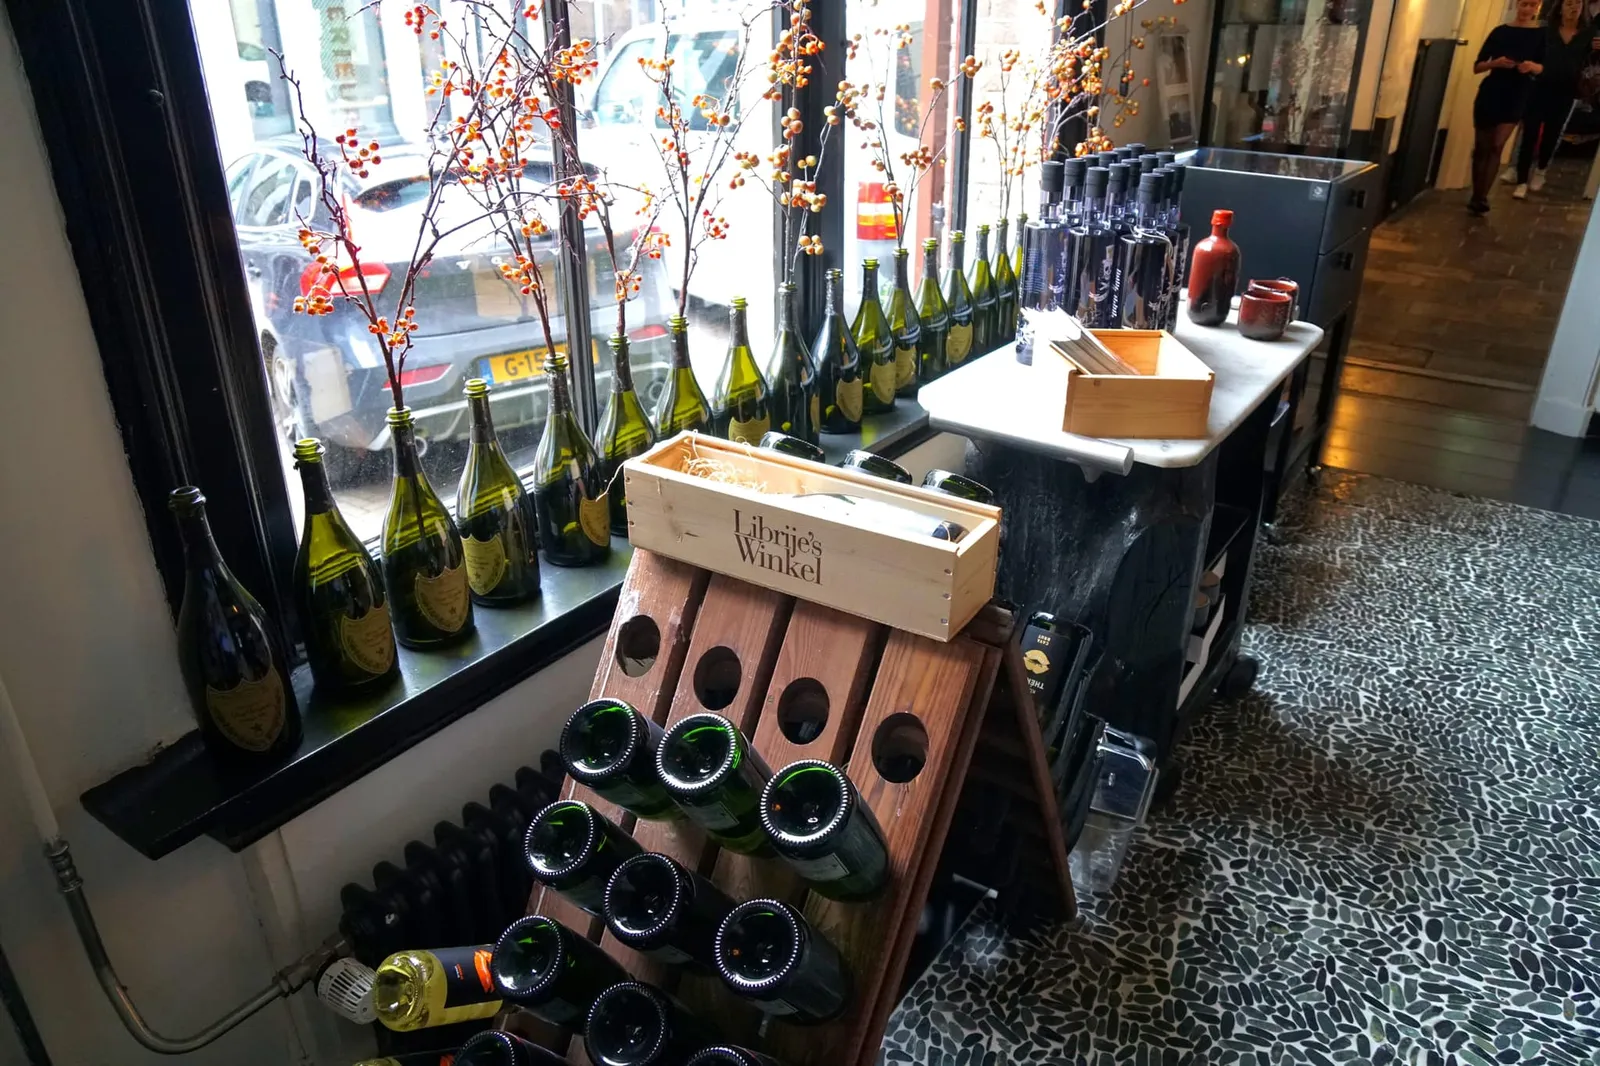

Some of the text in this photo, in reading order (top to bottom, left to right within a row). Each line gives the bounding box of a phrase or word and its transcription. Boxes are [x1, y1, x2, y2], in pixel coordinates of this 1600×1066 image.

[504, 352, 549, 376] G-15
[733, 508, 822, 558] Librije's
[734, 533, 822, 585] Winkel
